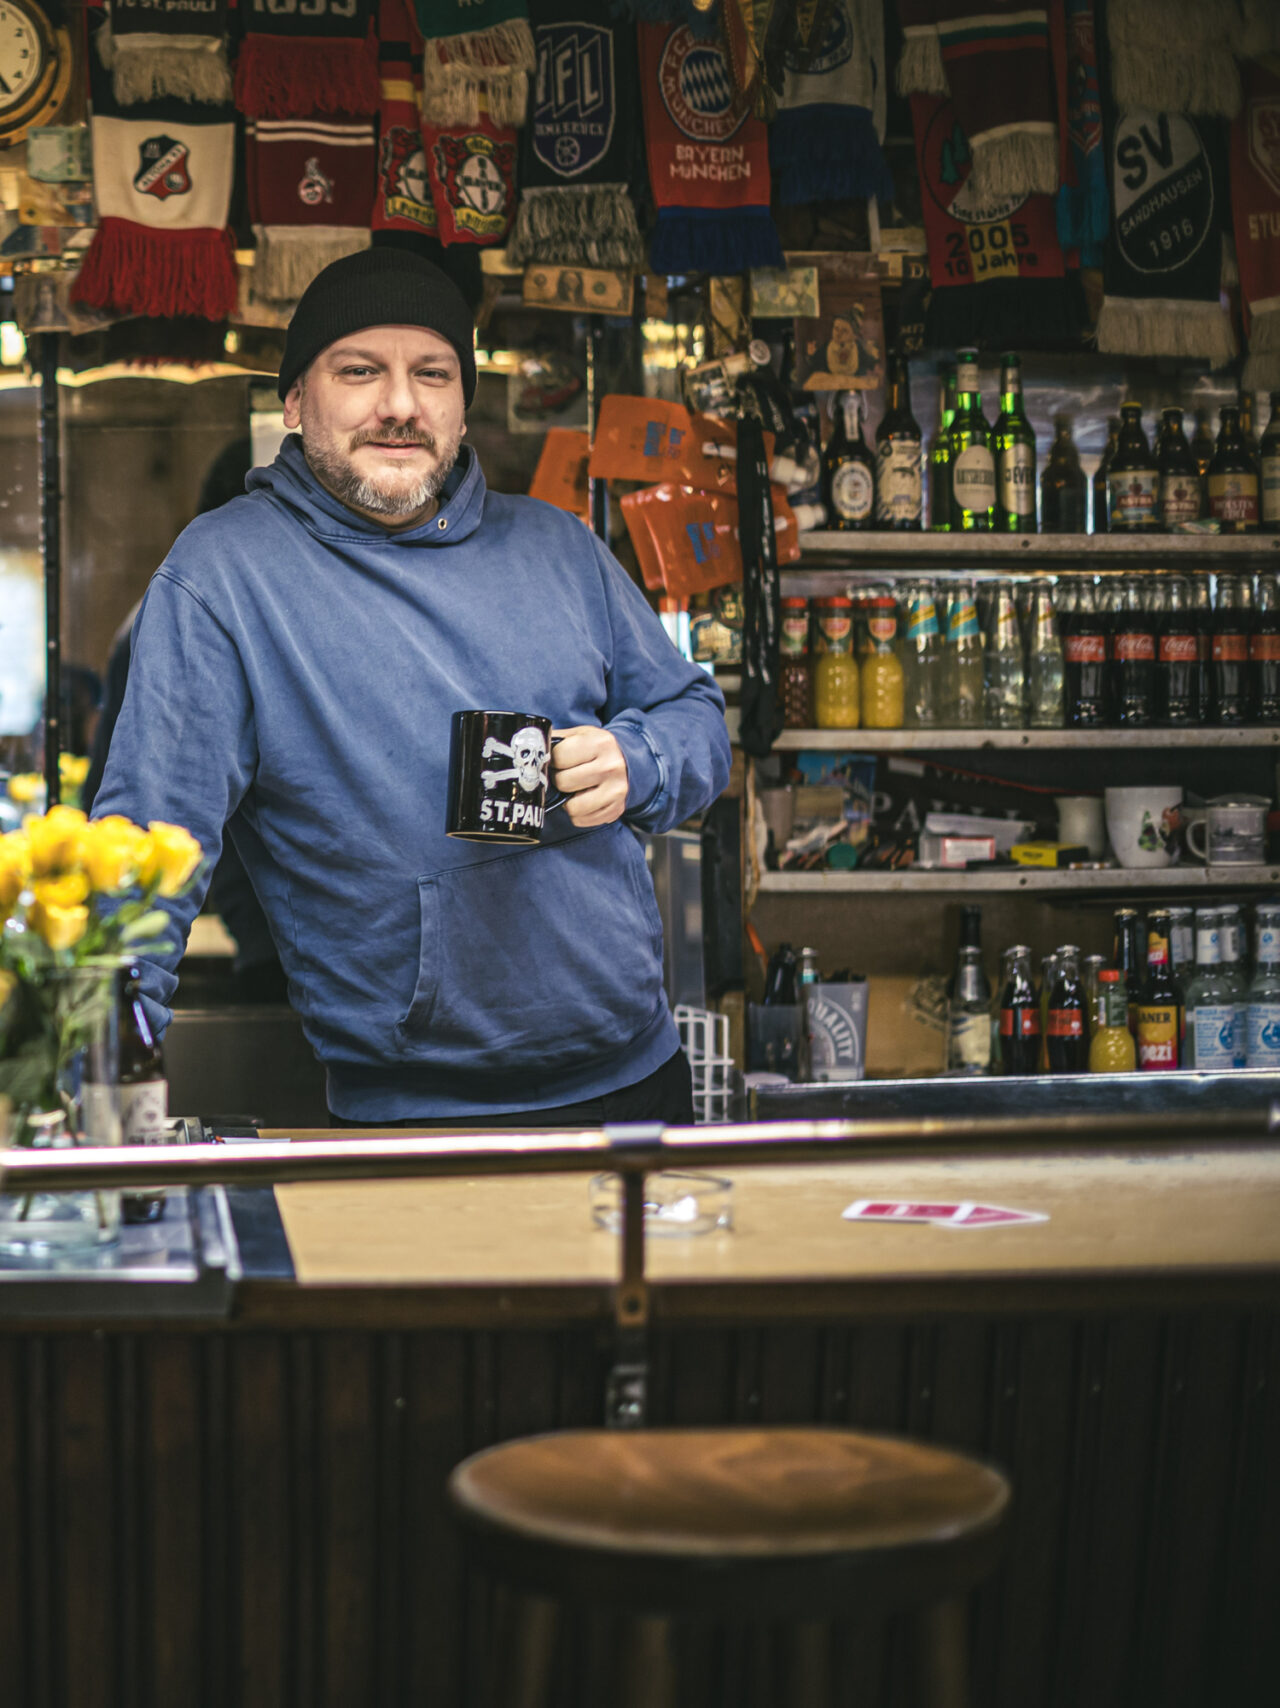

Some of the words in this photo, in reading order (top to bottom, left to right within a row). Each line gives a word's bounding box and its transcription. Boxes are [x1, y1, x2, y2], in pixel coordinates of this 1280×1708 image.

[675, 144, 744, 163] BAYERN
[1117, 112, 1173, 190] SV
[1120, 167, 1204, 237] SANDHAUSEN
[945, 223, 1030, 259] 2005
[1149, 218, 1194, 257] 1916
[944, 258, 969, 278] 10
[977, 250, 1039, 272] Jahre
[480, 800, 510, 823] ST.
